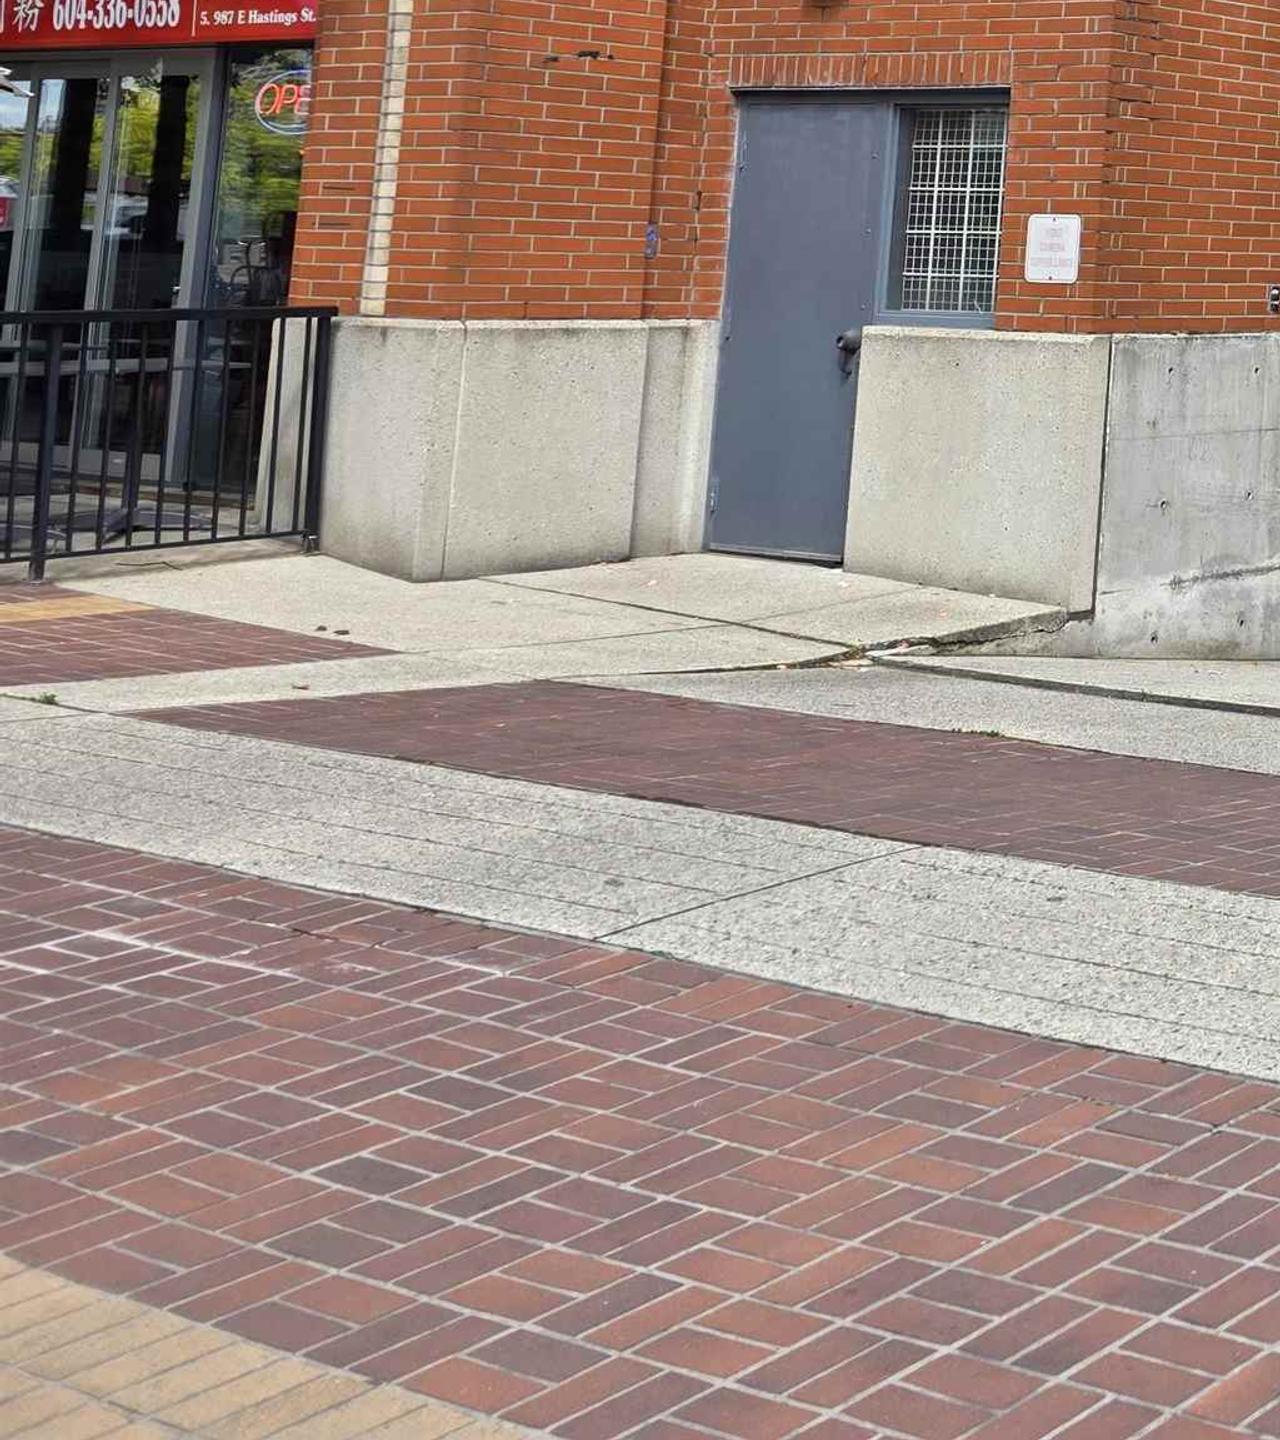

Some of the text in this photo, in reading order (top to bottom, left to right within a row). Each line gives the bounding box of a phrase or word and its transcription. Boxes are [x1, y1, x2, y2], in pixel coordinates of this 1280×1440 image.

[200, 8, 316, 25] 5. 987 E Hastings St.
[256, 84, 311, 115] OPE
